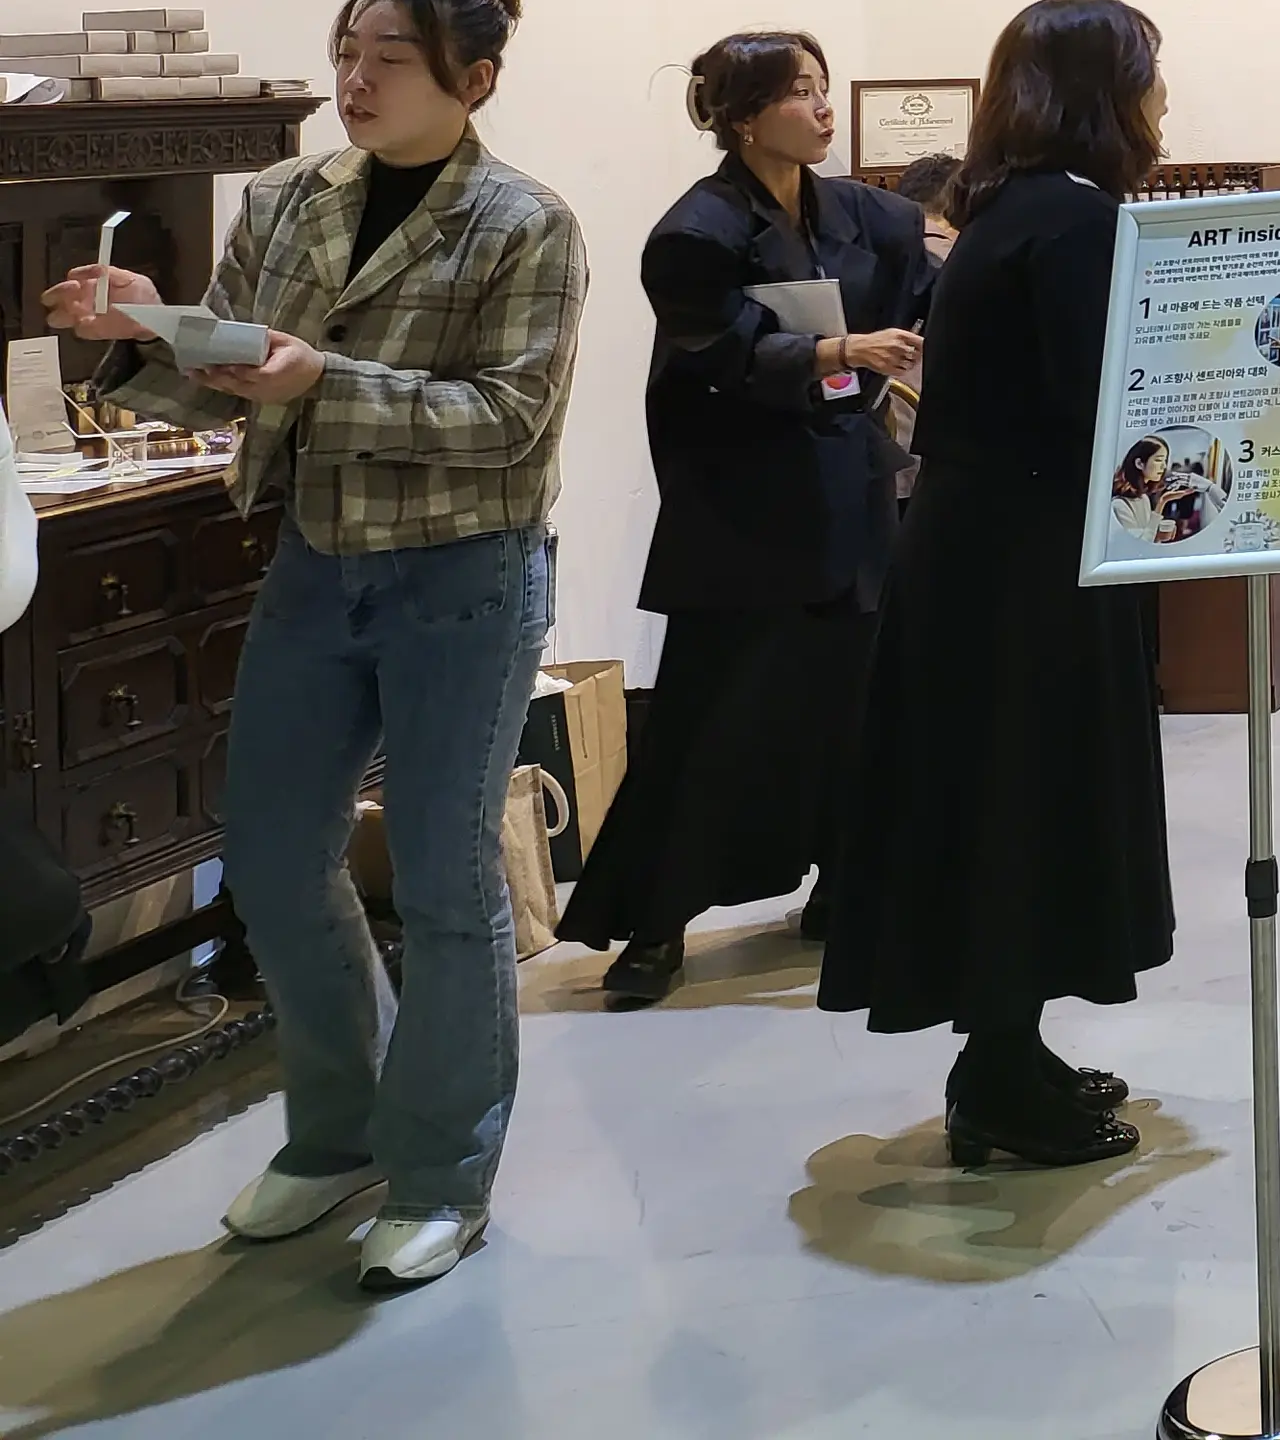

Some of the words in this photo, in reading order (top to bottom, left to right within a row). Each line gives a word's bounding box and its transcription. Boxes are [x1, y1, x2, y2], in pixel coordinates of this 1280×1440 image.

[1187, 228, 1233, 249] ART
[1139, 298, 1151, 319] 1
[1157, 303, 1168, 313] 내
[1170, 301, 1199, 312] 마음에
[1201, 300, 1220, 310] 드는
[1224, 297, 1243, 308] 작품
[1245, 295, 1265, 307] 선택
[1128, 369, 1145, 391] 2
[1150, 376, 1161, 385] AI
[1163, 372, 1192, 384] 조향사
[1195, 368, 1245, 382] 센트리아와
[1248, 366, 1267, 377] 대화
[1238, 440, 1255, 464] 3
